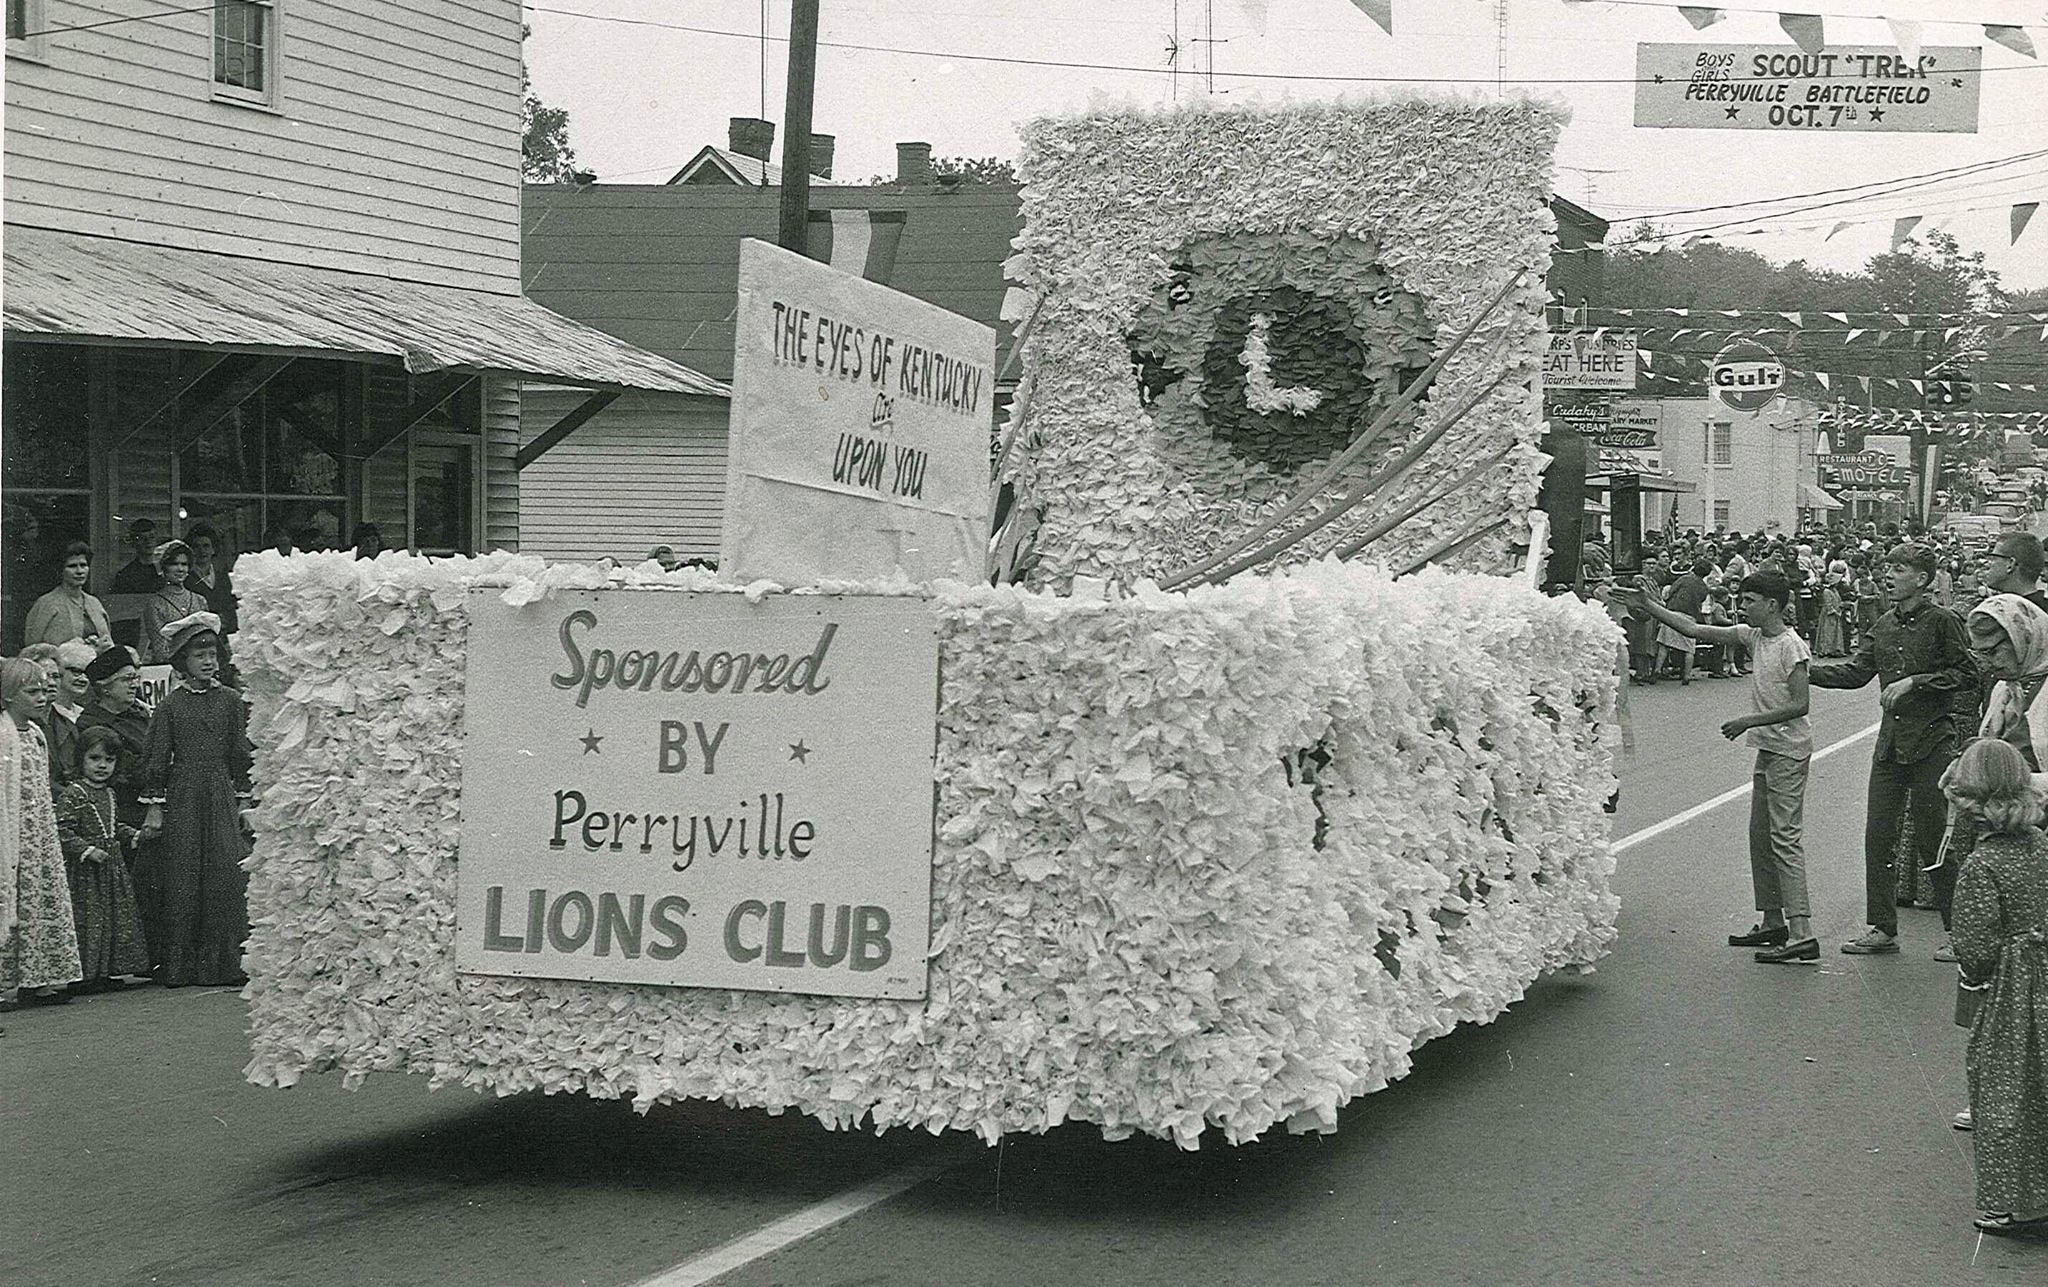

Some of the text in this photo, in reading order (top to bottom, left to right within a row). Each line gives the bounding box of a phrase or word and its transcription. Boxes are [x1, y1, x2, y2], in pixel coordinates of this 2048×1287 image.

[1696, 52, 1735, 67] BOYS
[1753, 54, 1838, 77] SCOUT
[1691, 68, 1730, 82] GIRLS
[1685, 83, 1930, 104] PERRYVILLE BATTLEFIELD
[1768, 105, 1822, 127] OCT.
[772, 301, 982, 414] THE EYES OF KENTUCKY
[1580, 354, 1625, 372] HERE
[1552, 404, 1605, 422] Cudahy's
[1628, 418, 1658, 426] MARKET
[1572, 422, 1607, 434] CREAM
[832, 432, 928, 500] UPON YOU
[1819, 454, 1873, 464] RESTAURANT
[1840, 468, 1900, 483] MOTEL
[550, 609, 839, 709] Sponsored
[657, 720, 730, 775] BY
[549, 788, 816, 873] Perryville
[482, 886, 893, 973] LIONS CLUB
